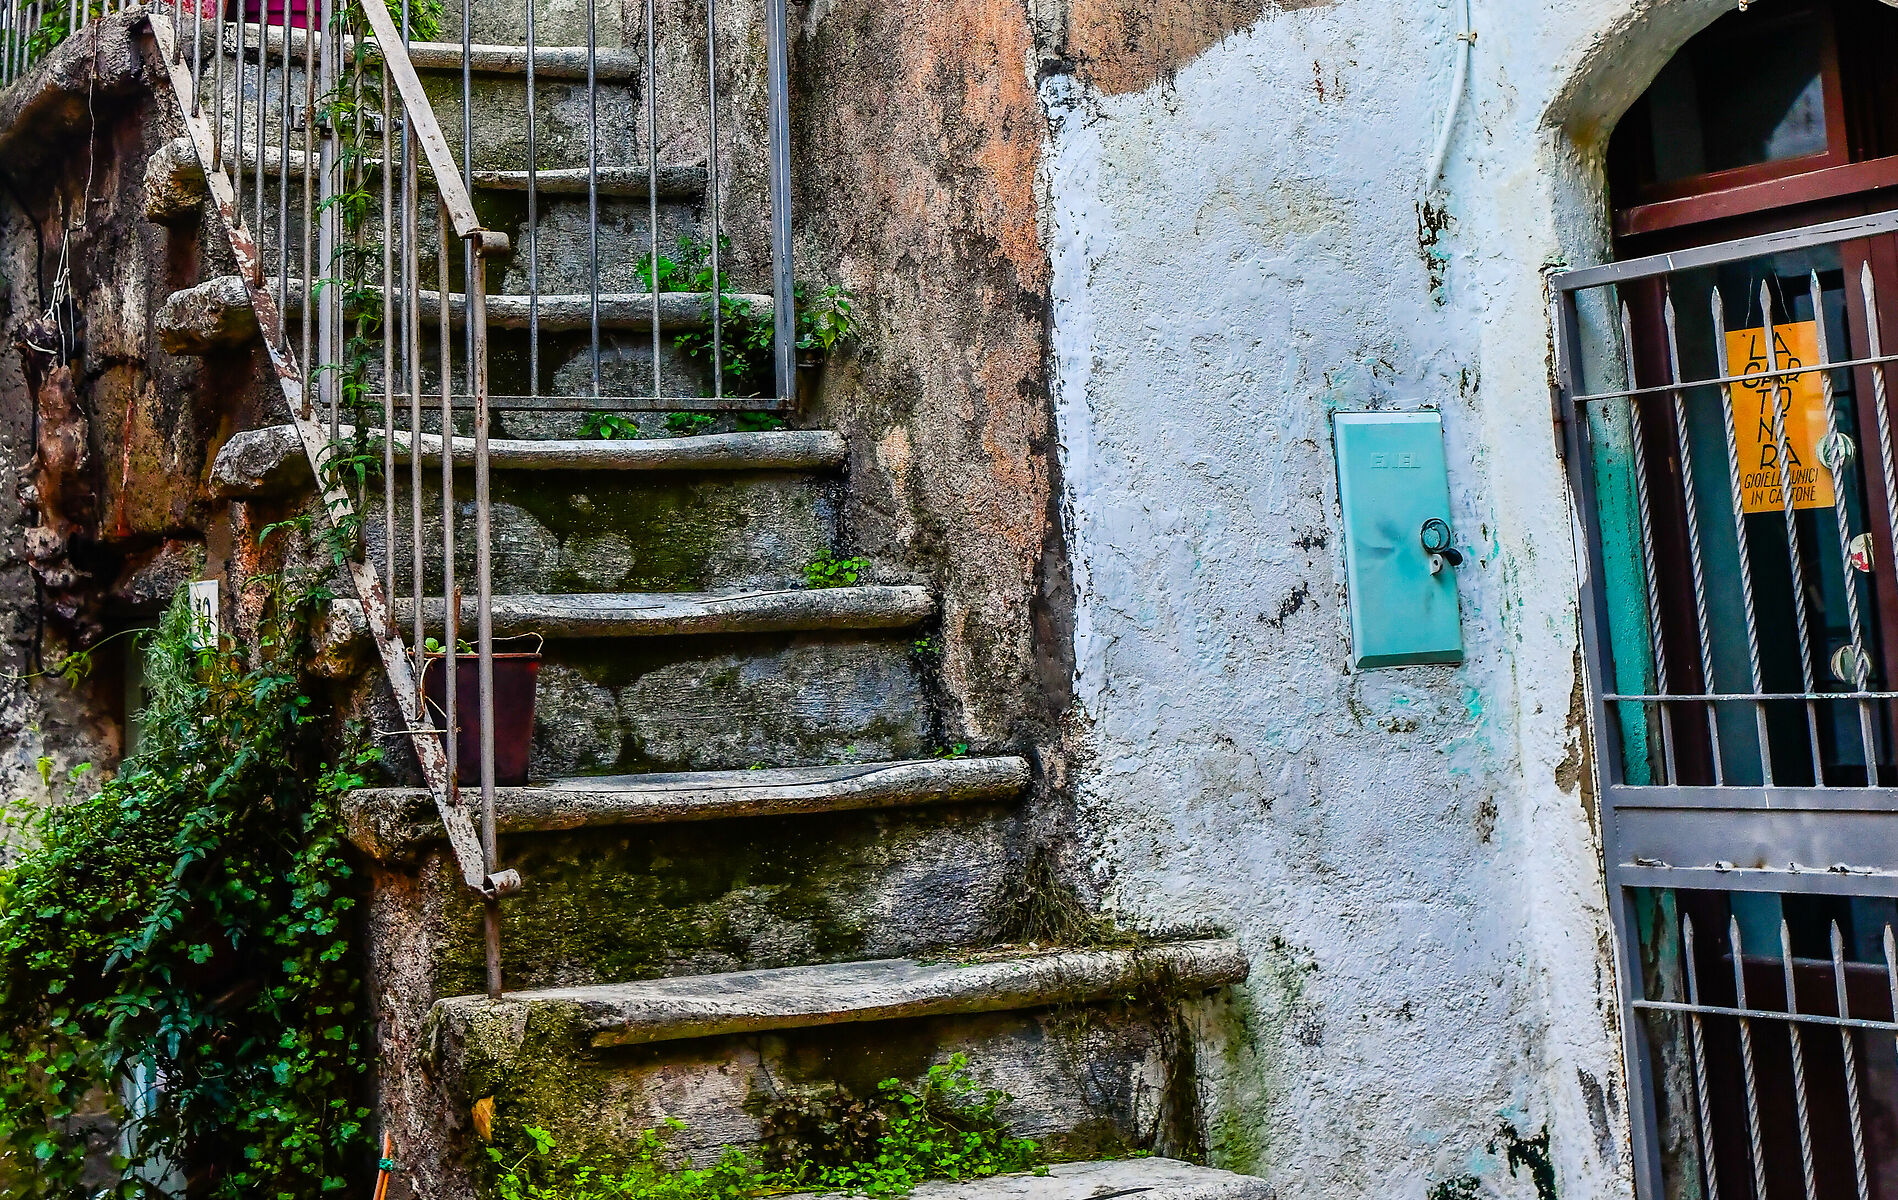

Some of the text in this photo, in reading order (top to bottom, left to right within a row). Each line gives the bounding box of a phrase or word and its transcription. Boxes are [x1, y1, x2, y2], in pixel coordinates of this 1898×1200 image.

[1749, 332, 1792, 361] LA
[1760, 443, 1801, 470] RA
[1744, 467, 1818, 489] GIOIELL UNICI
[1750, 485, 1816, 506] IN CATONE
